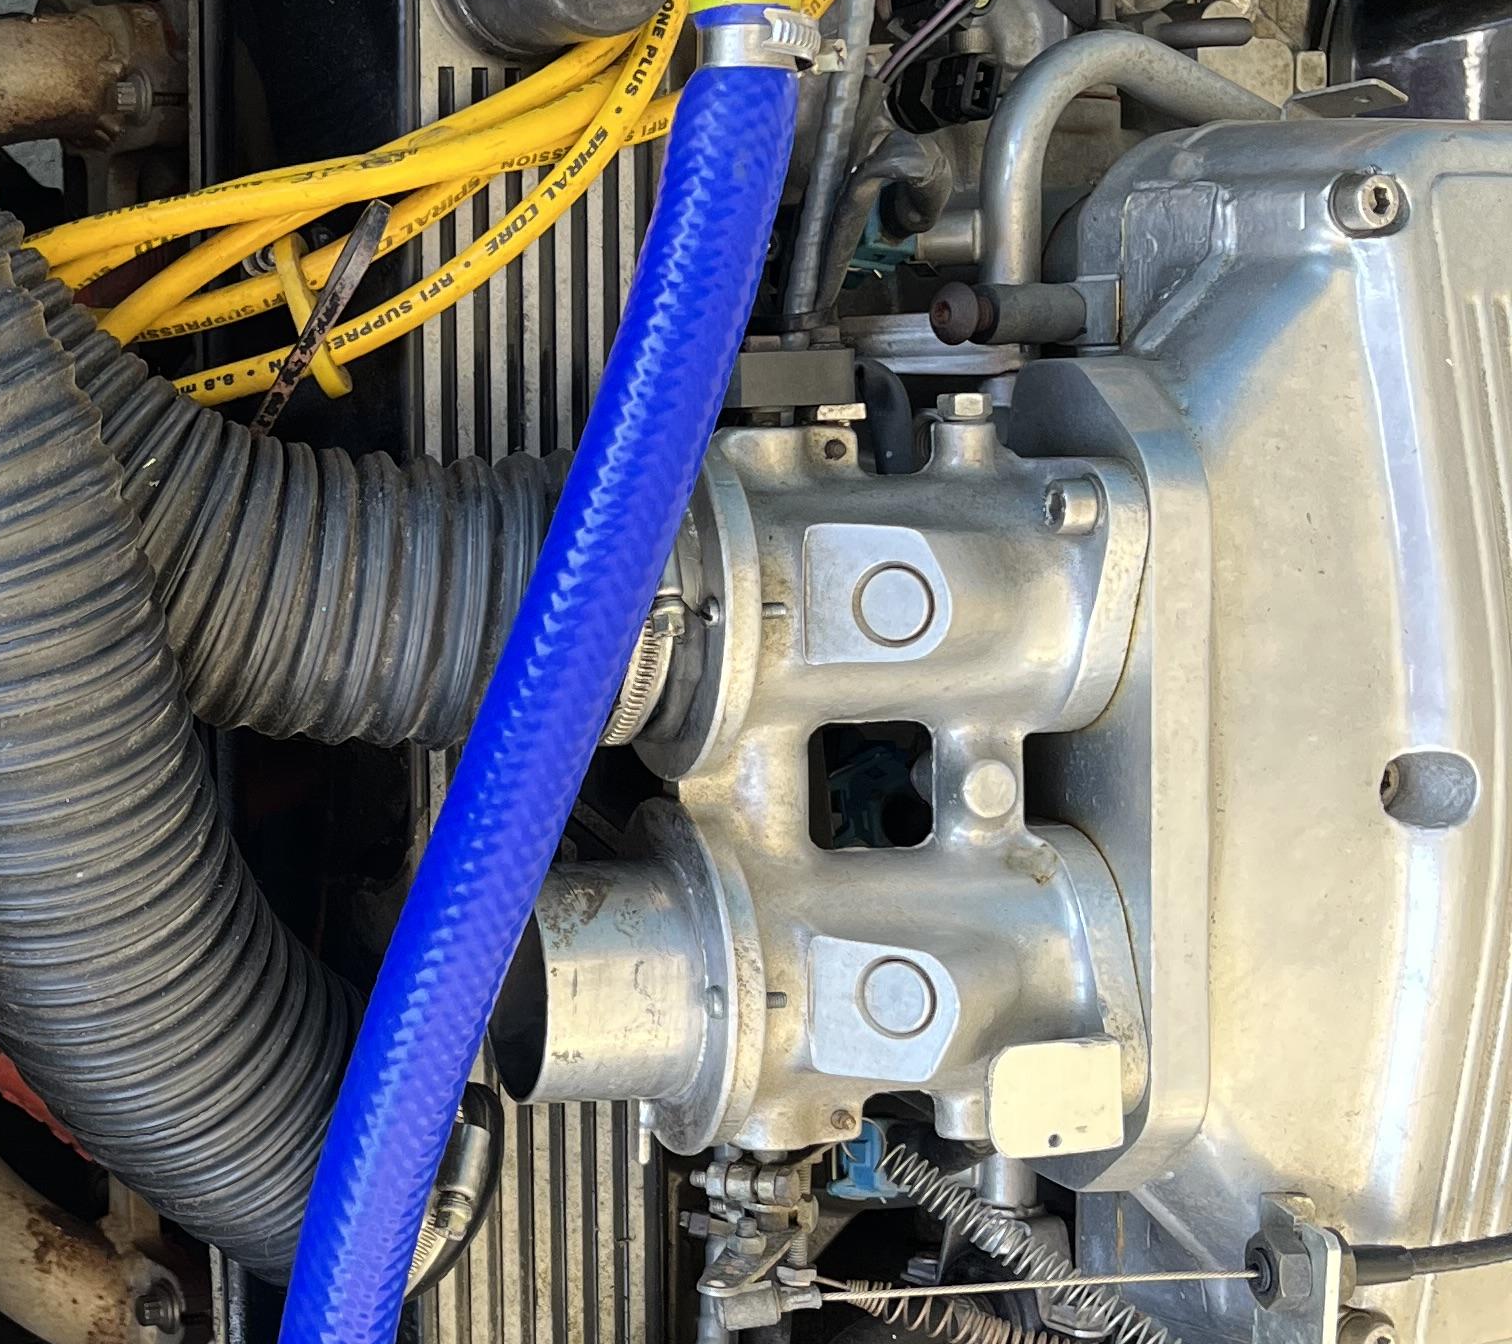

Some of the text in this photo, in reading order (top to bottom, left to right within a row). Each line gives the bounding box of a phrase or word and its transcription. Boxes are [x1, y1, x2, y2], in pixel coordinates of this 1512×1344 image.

[625, 44, 659, 96] PLUS
[540, 126, 609, 201] SPIRAL
[399, 176, 481, 236] SPIRAL
[484, 203, 540, 256] CORE
[420, 271, 455, 303] RFI
[204, 373, 234, 391] 8.8
